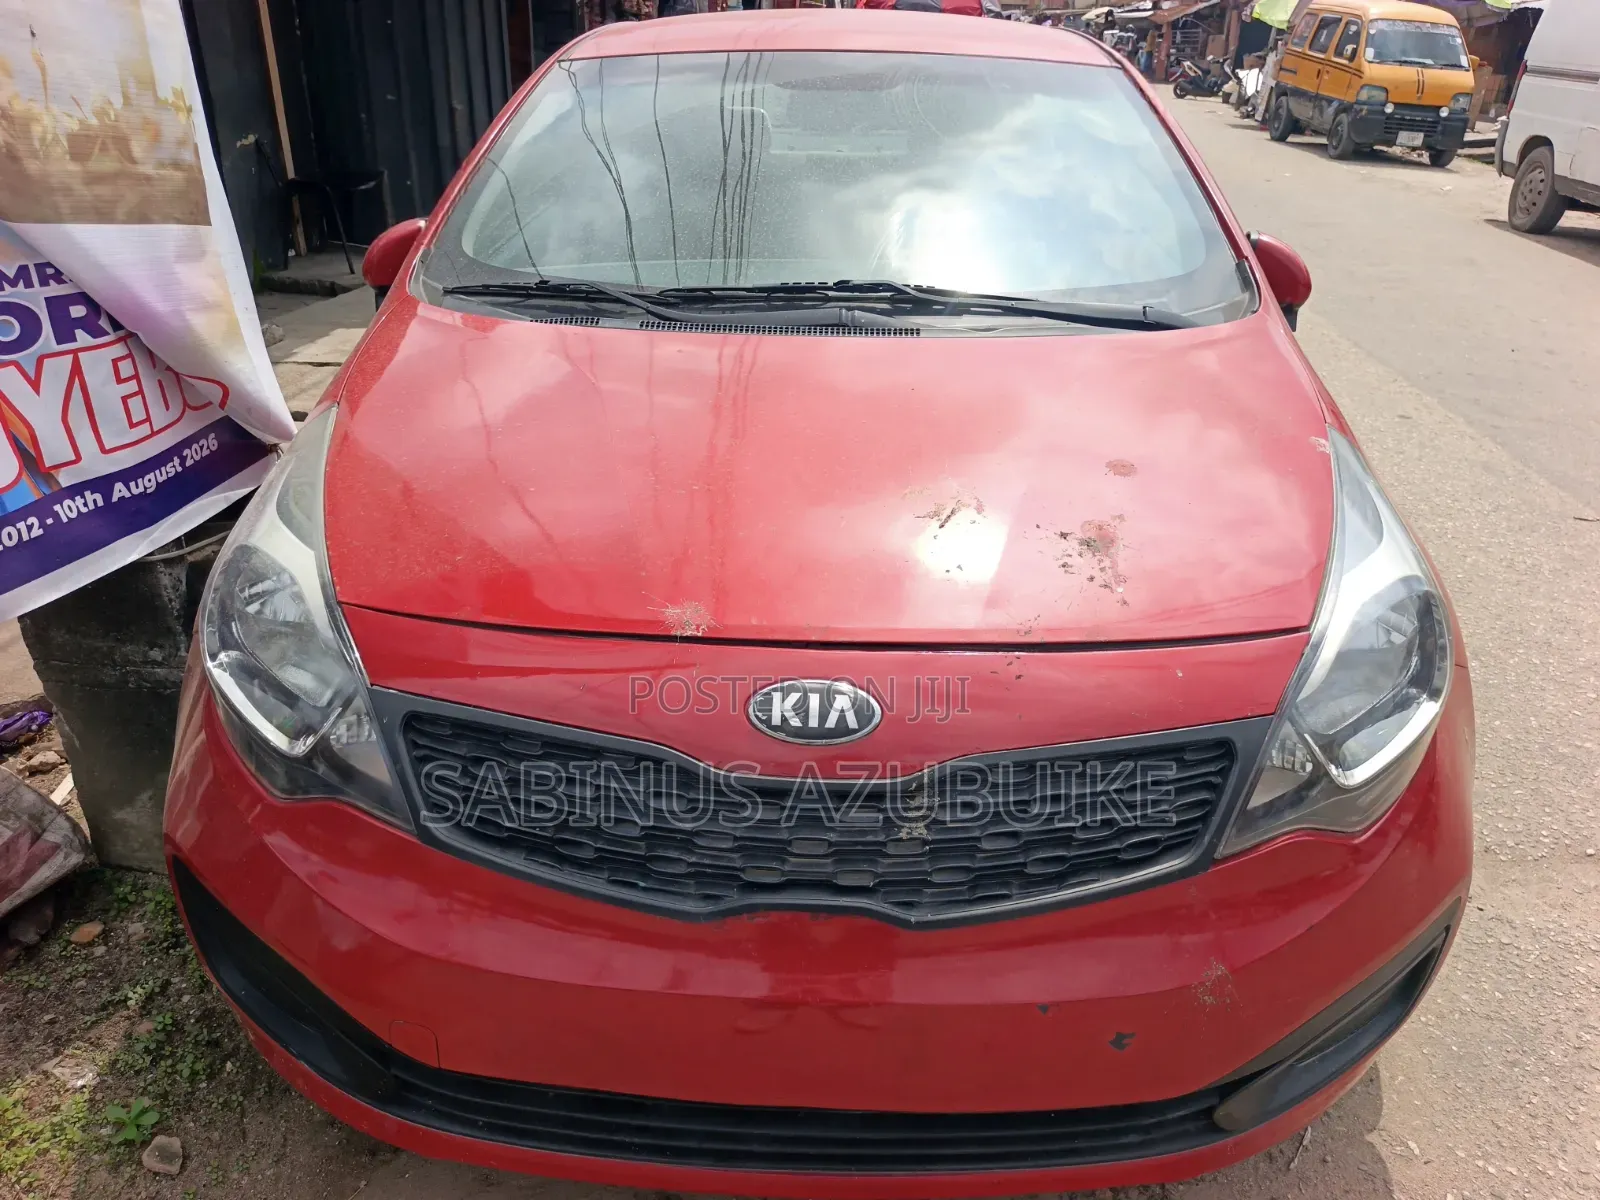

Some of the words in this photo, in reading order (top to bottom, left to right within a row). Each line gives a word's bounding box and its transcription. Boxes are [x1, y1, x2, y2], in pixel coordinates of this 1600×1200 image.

[0, 261, 73, 291] MR
[0, 291, 125, 354] OR
[0, 516, 44, 551] 012
[53, 490, 104, 524] 10th
[111, 456, 182, 503] August
[183, 432, 219, 468] 2026
[771, 691, 859, 729] KIA
